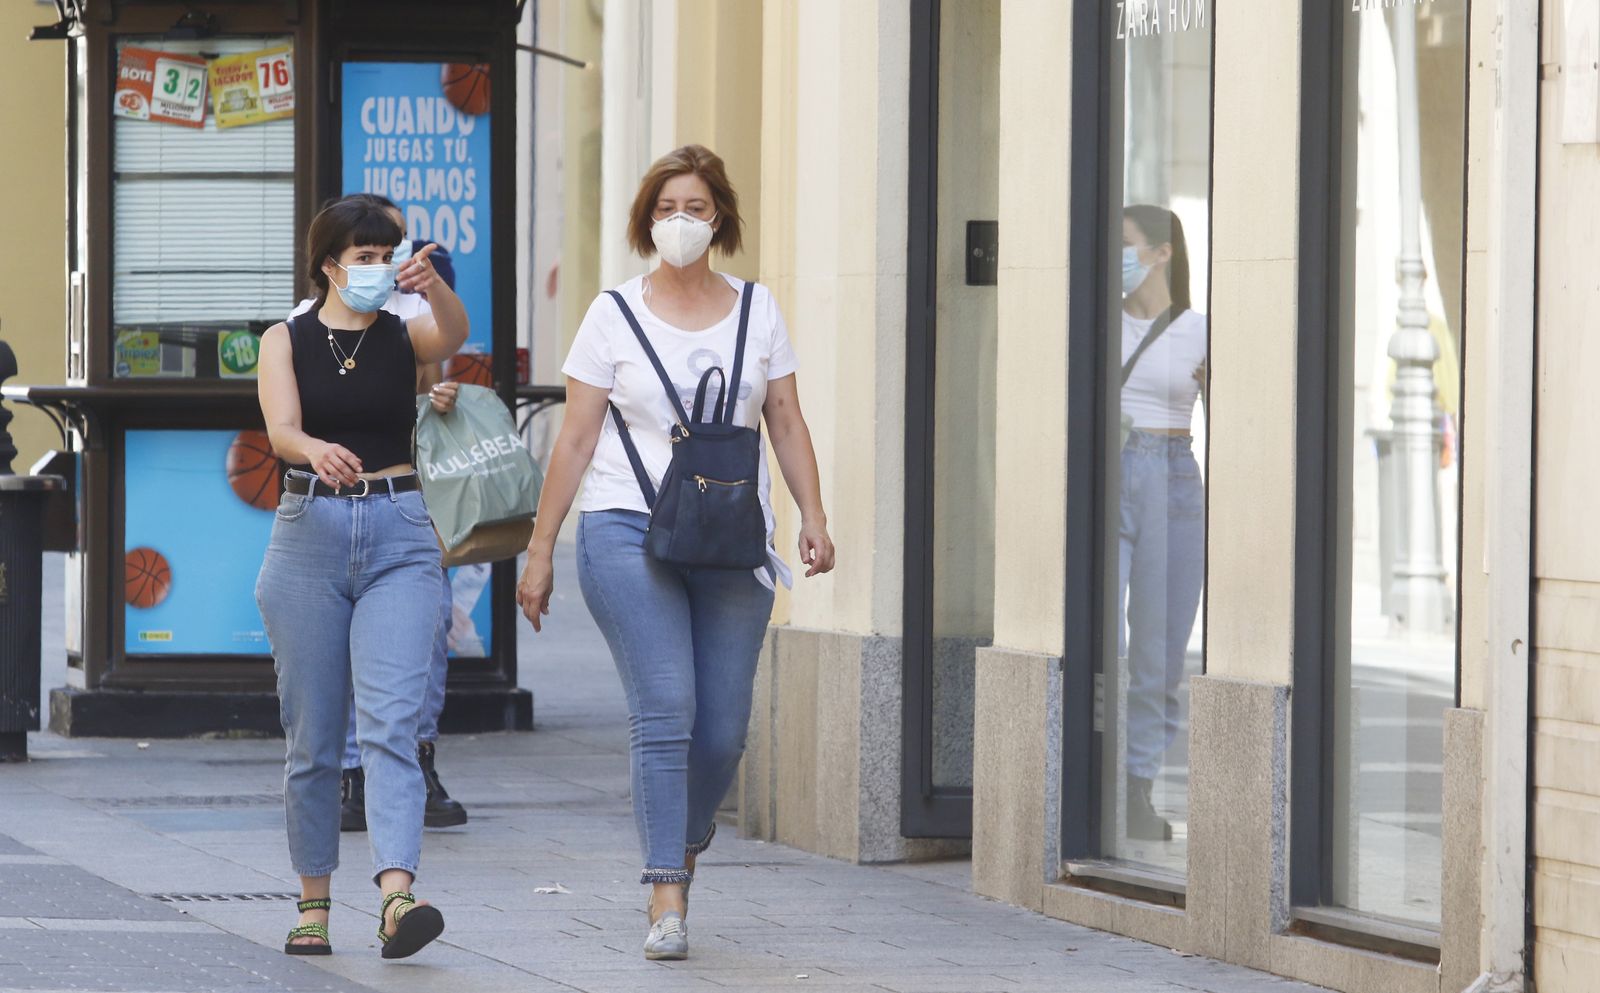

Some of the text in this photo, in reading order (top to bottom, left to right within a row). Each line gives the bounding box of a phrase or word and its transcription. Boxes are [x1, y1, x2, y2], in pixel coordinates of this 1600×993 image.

[1116, 0, 1160, 39] ZARA
[121, 66, 153, 83] BOTE
[259, 59, 289, 89] 76
[364, 137, 434, 163] JUEGAS
[363, 167, 477, 201] JUGAMOS
